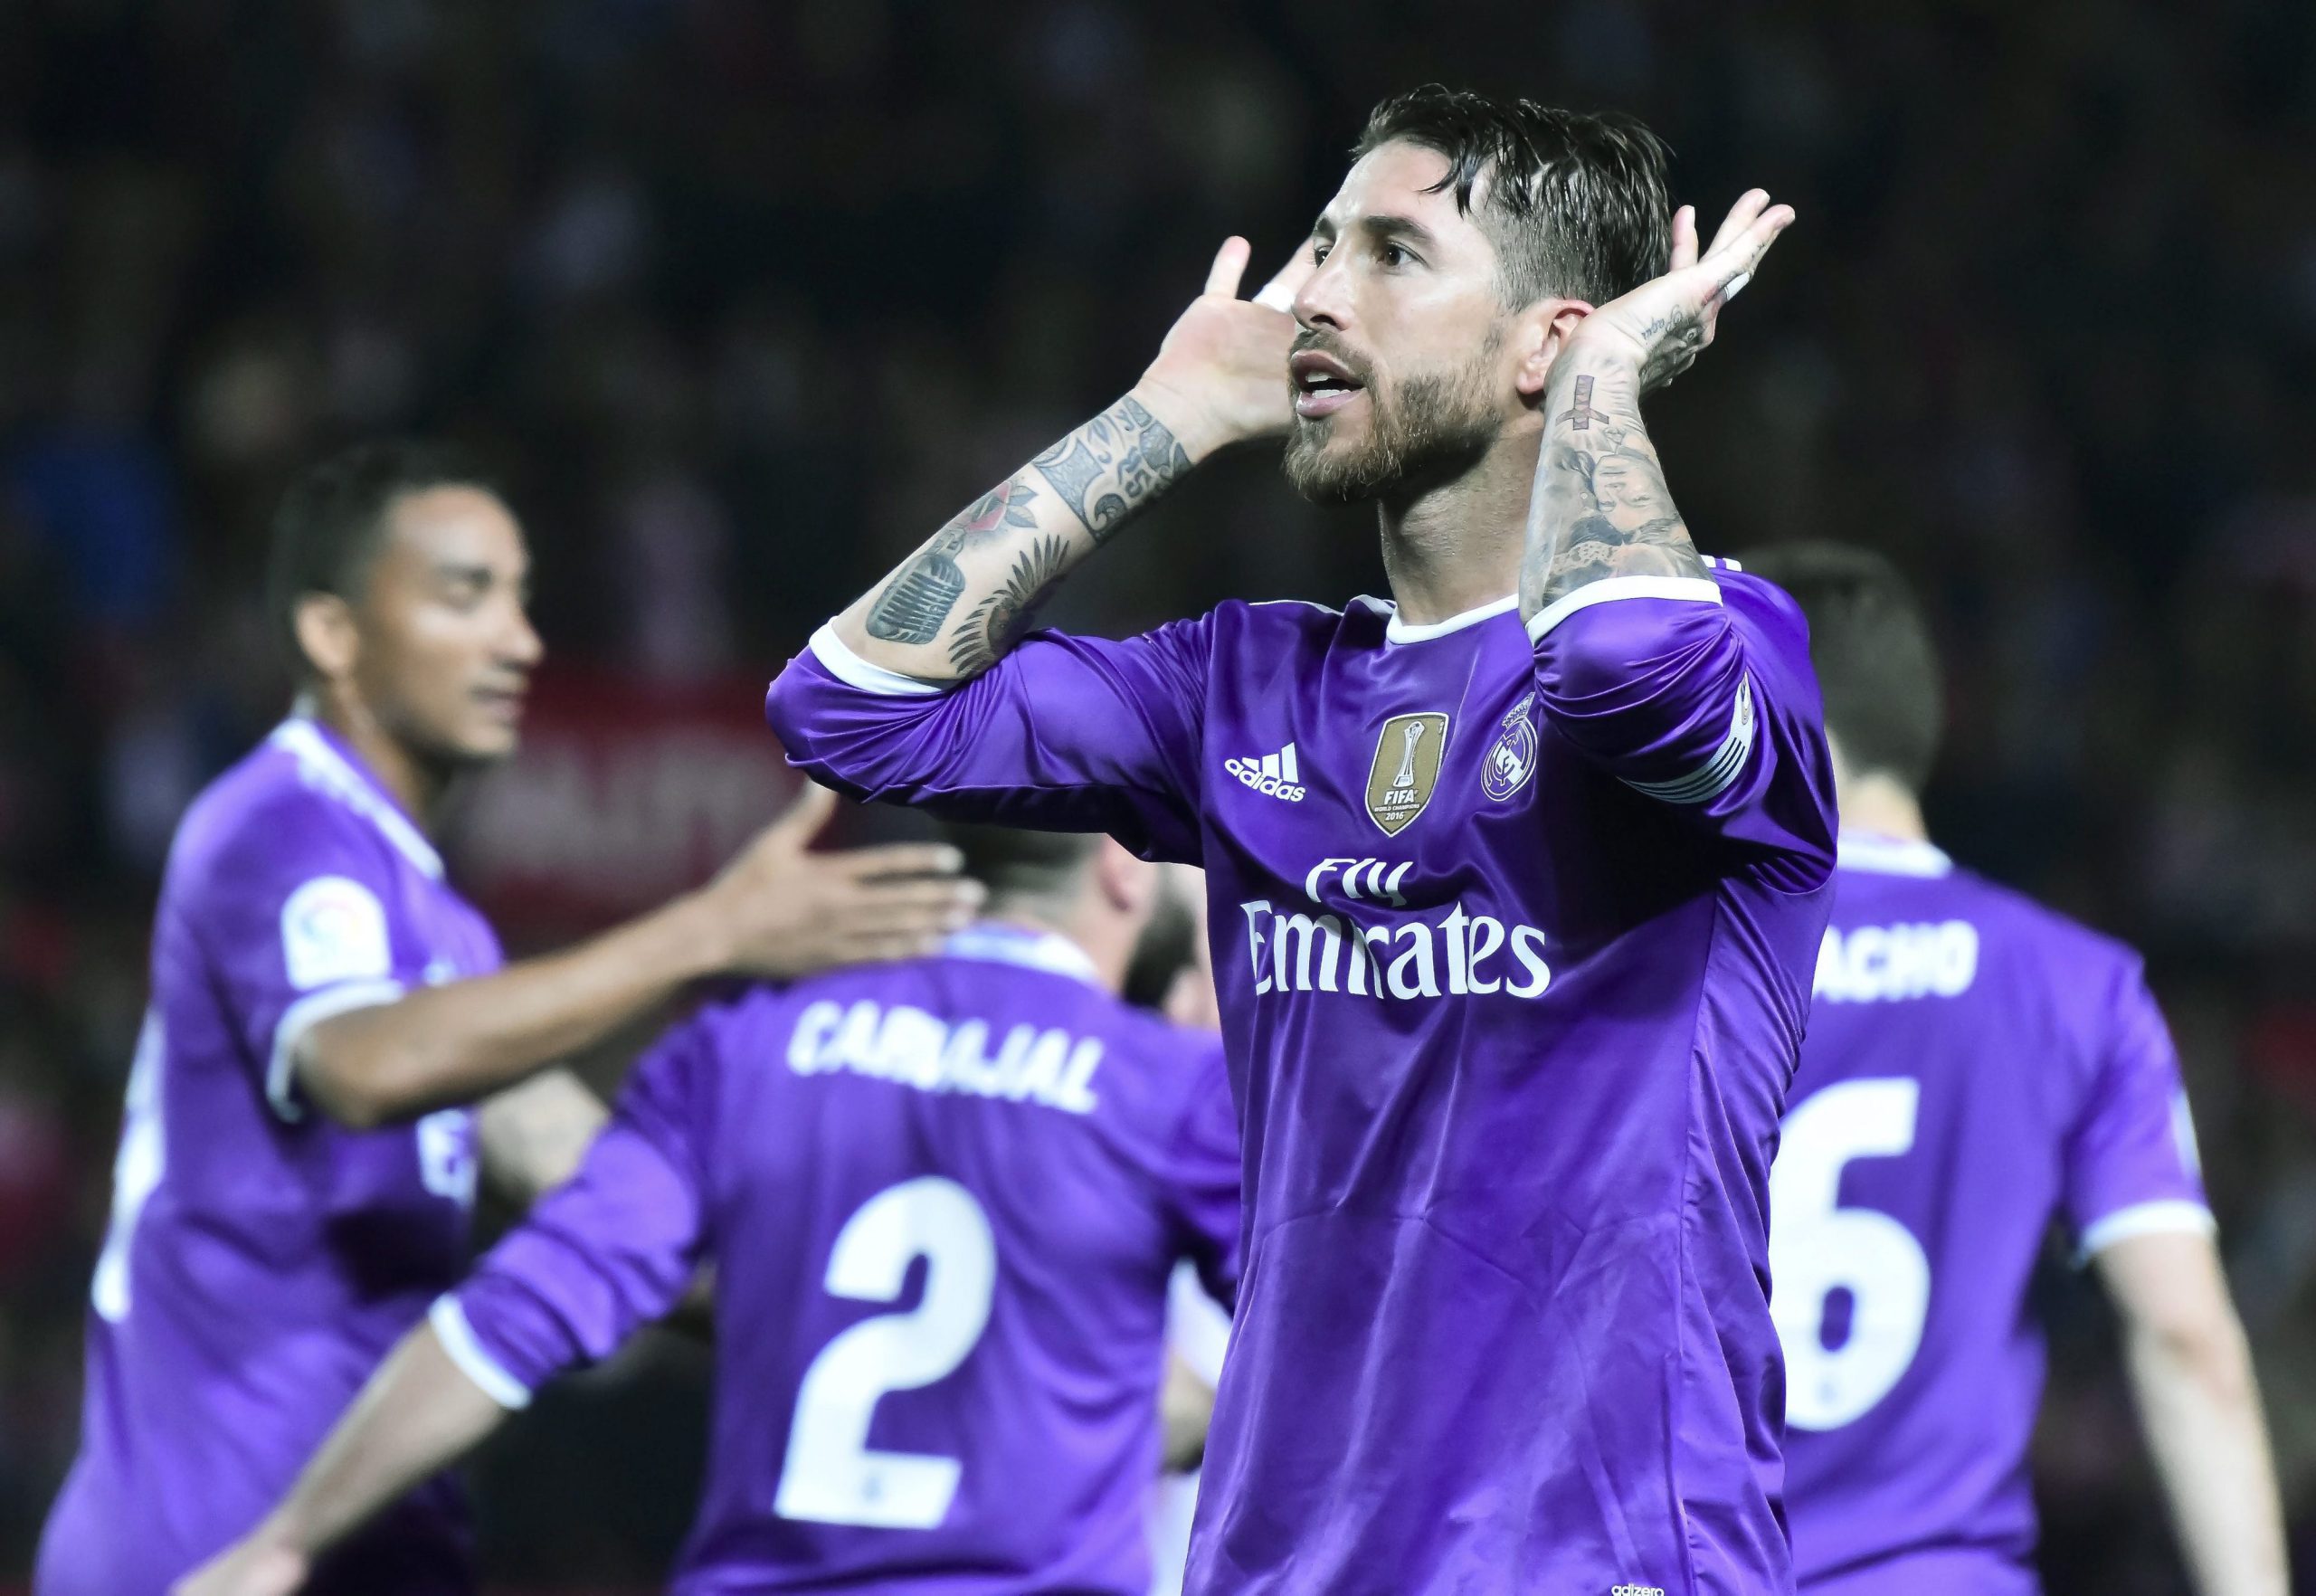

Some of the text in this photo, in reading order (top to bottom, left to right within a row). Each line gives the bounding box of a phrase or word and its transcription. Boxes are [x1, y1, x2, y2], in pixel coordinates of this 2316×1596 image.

[1224, 757, 1306, 803] adidas
[1384, 790, 1414, 804] FIFA
[1385, 812, 1405, 821] 2016
[1305, 858, 1413, 906] Fly
[1240, 900, 1551, 1000] Emirates
[1769, 1076, 1931, 1430] 6
[774, 1175, 996, 1529] 2
